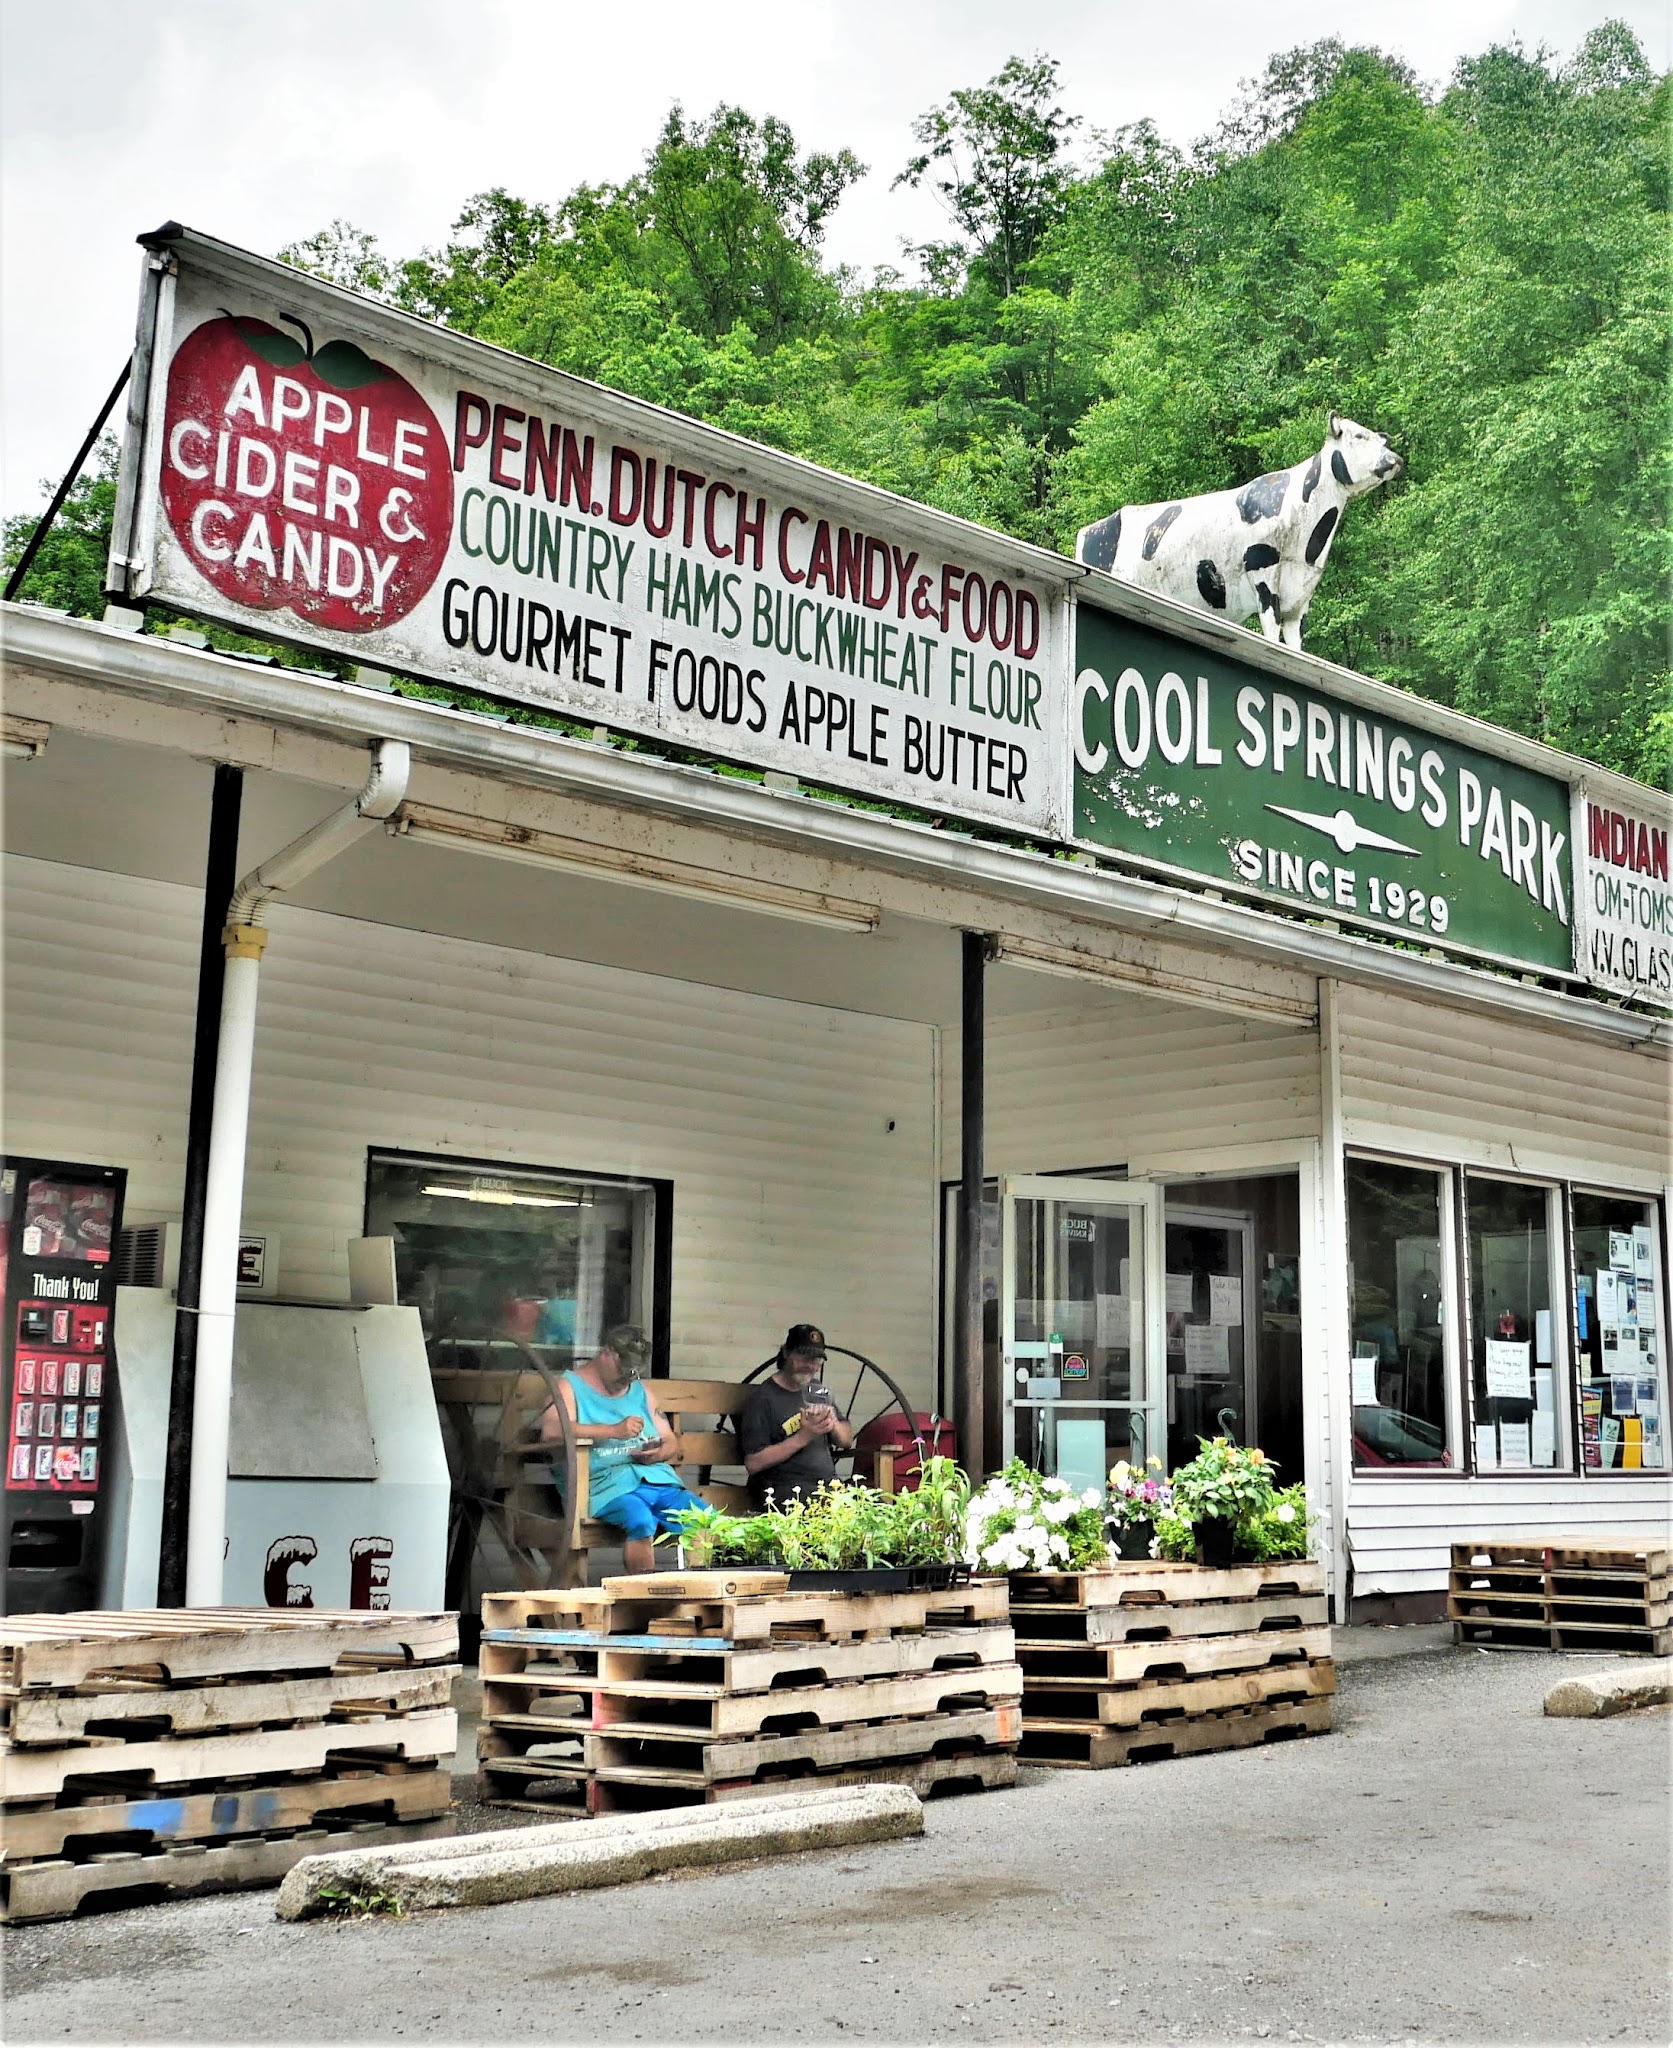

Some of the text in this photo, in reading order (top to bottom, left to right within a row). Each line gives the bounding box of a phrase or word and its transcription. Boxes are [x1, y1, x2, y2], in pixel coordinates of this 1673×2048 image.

[169, 419, 426, 542] CIDER &
[224, 364, 429, 480] APPLE
[192, 500, 398, 610] CANDY
[453, 389, 1040, 661] PENN. DUTCH CANDY & FOOD
[459, 487, 1042, 731] COUNTRY HAMS BUCKWHEAT FLOUR
[443, 577, 1027, 803] GOURMET FOODS APPLE BUTTER
[1074, 668, 1568, 926] COOL SPRINGS PARK
[1236, 838, 1450, 935] SINCE 1929
[1589, 869, 1673, 937] OM-TOMS
[33, 1273, 100, 1301] Thank You!
